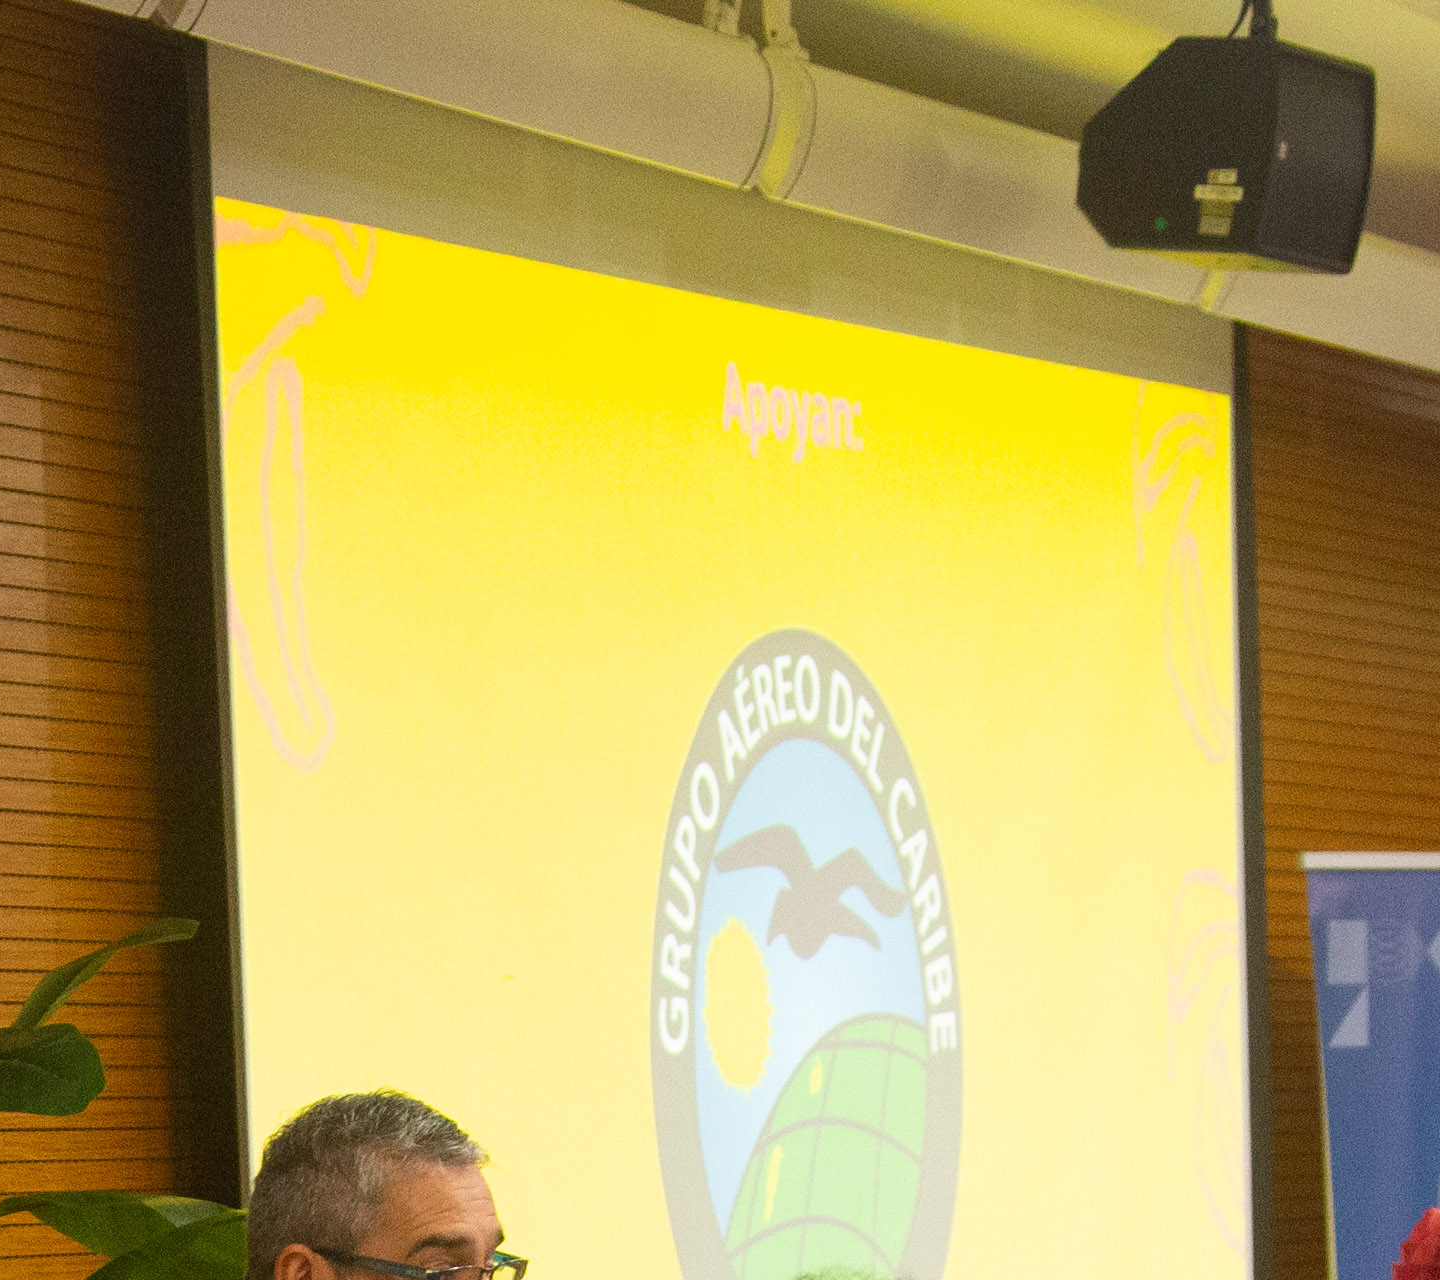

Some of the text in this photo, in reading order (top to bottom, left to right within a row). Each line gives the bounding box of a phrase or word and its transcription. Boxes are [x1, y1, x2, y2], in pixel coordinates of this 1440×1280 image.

[722, 359, 863, 464] Apoyan:
[658, 653, 957, 1054] GRUPO AÉREO DEL CARIBE
